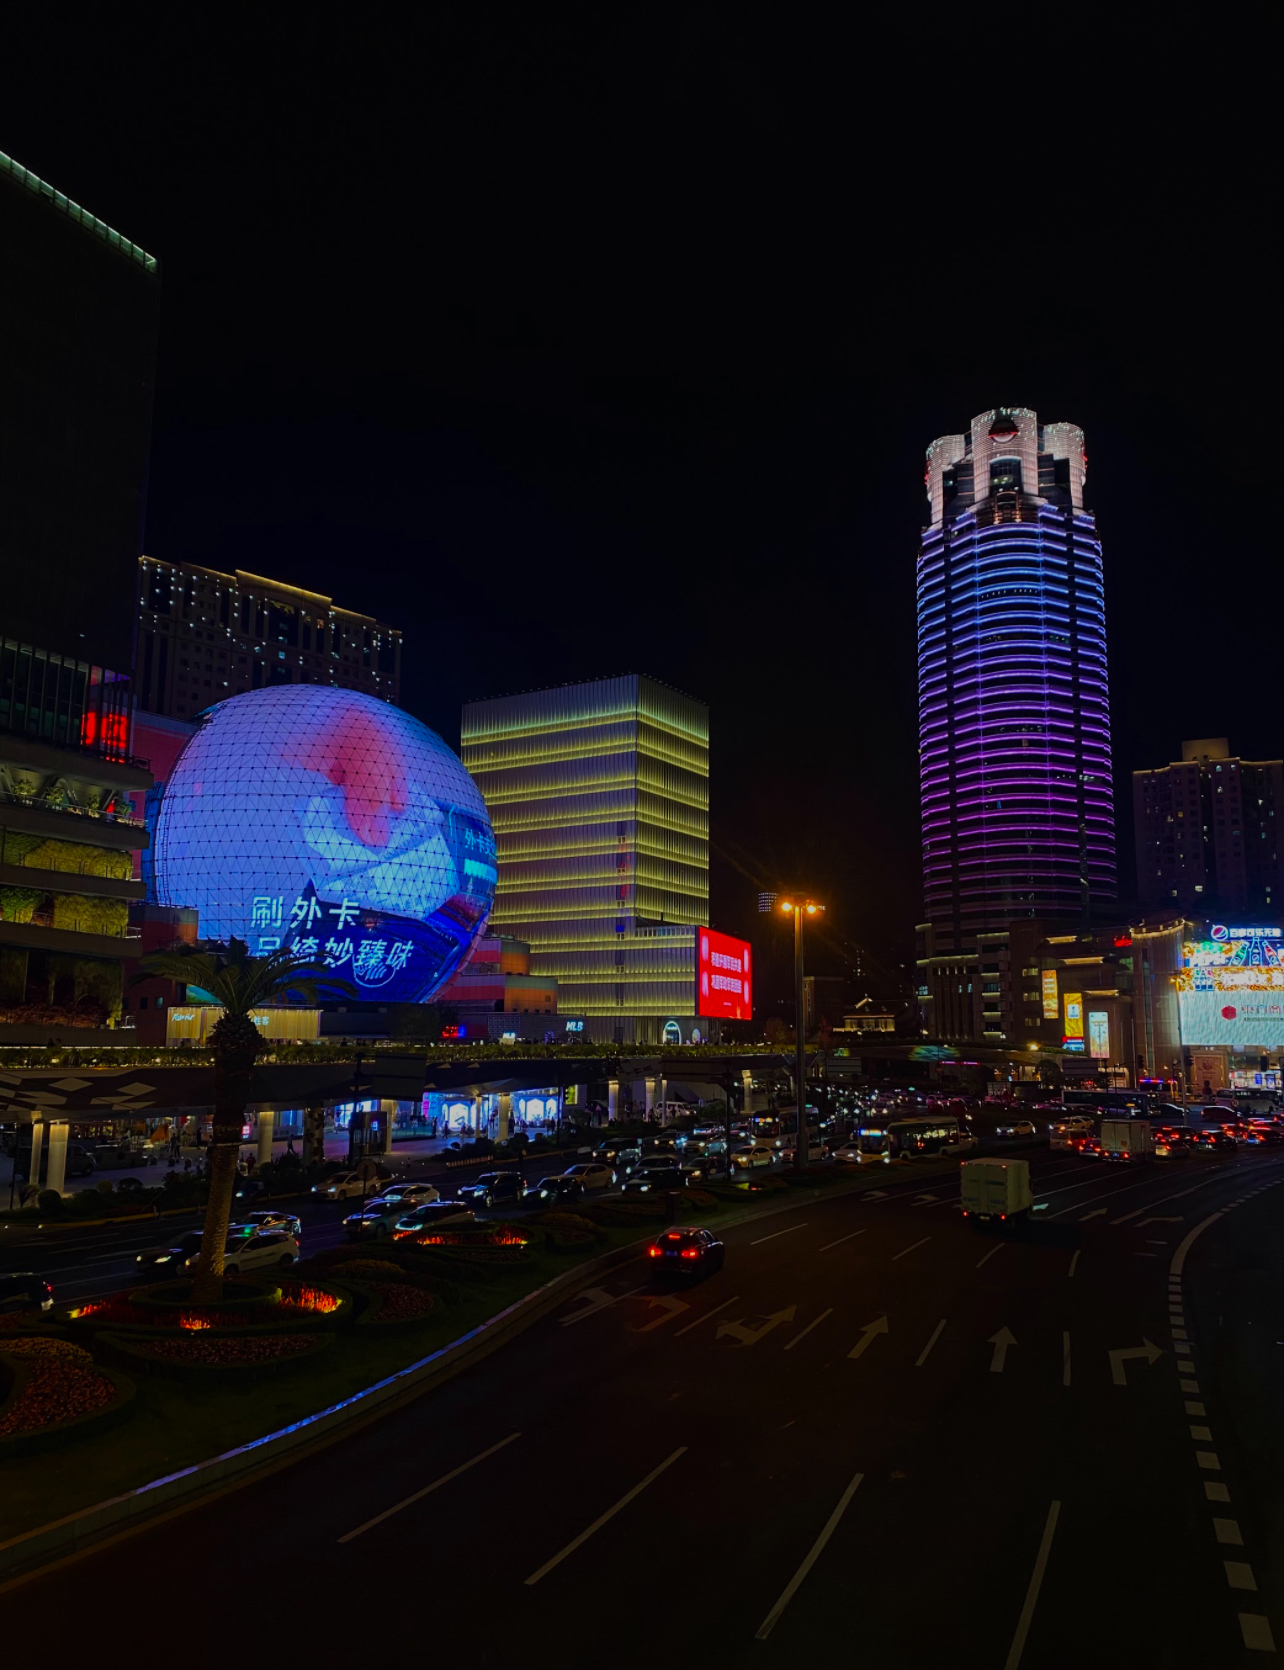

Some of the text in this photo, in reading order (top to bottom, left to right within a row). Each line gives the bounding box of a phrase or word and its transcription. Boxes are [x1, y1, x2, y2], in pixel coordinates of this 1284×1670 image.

[250, 895, 361, 931] 刷外卡
[566, 1021, 584, 1032] MLB
